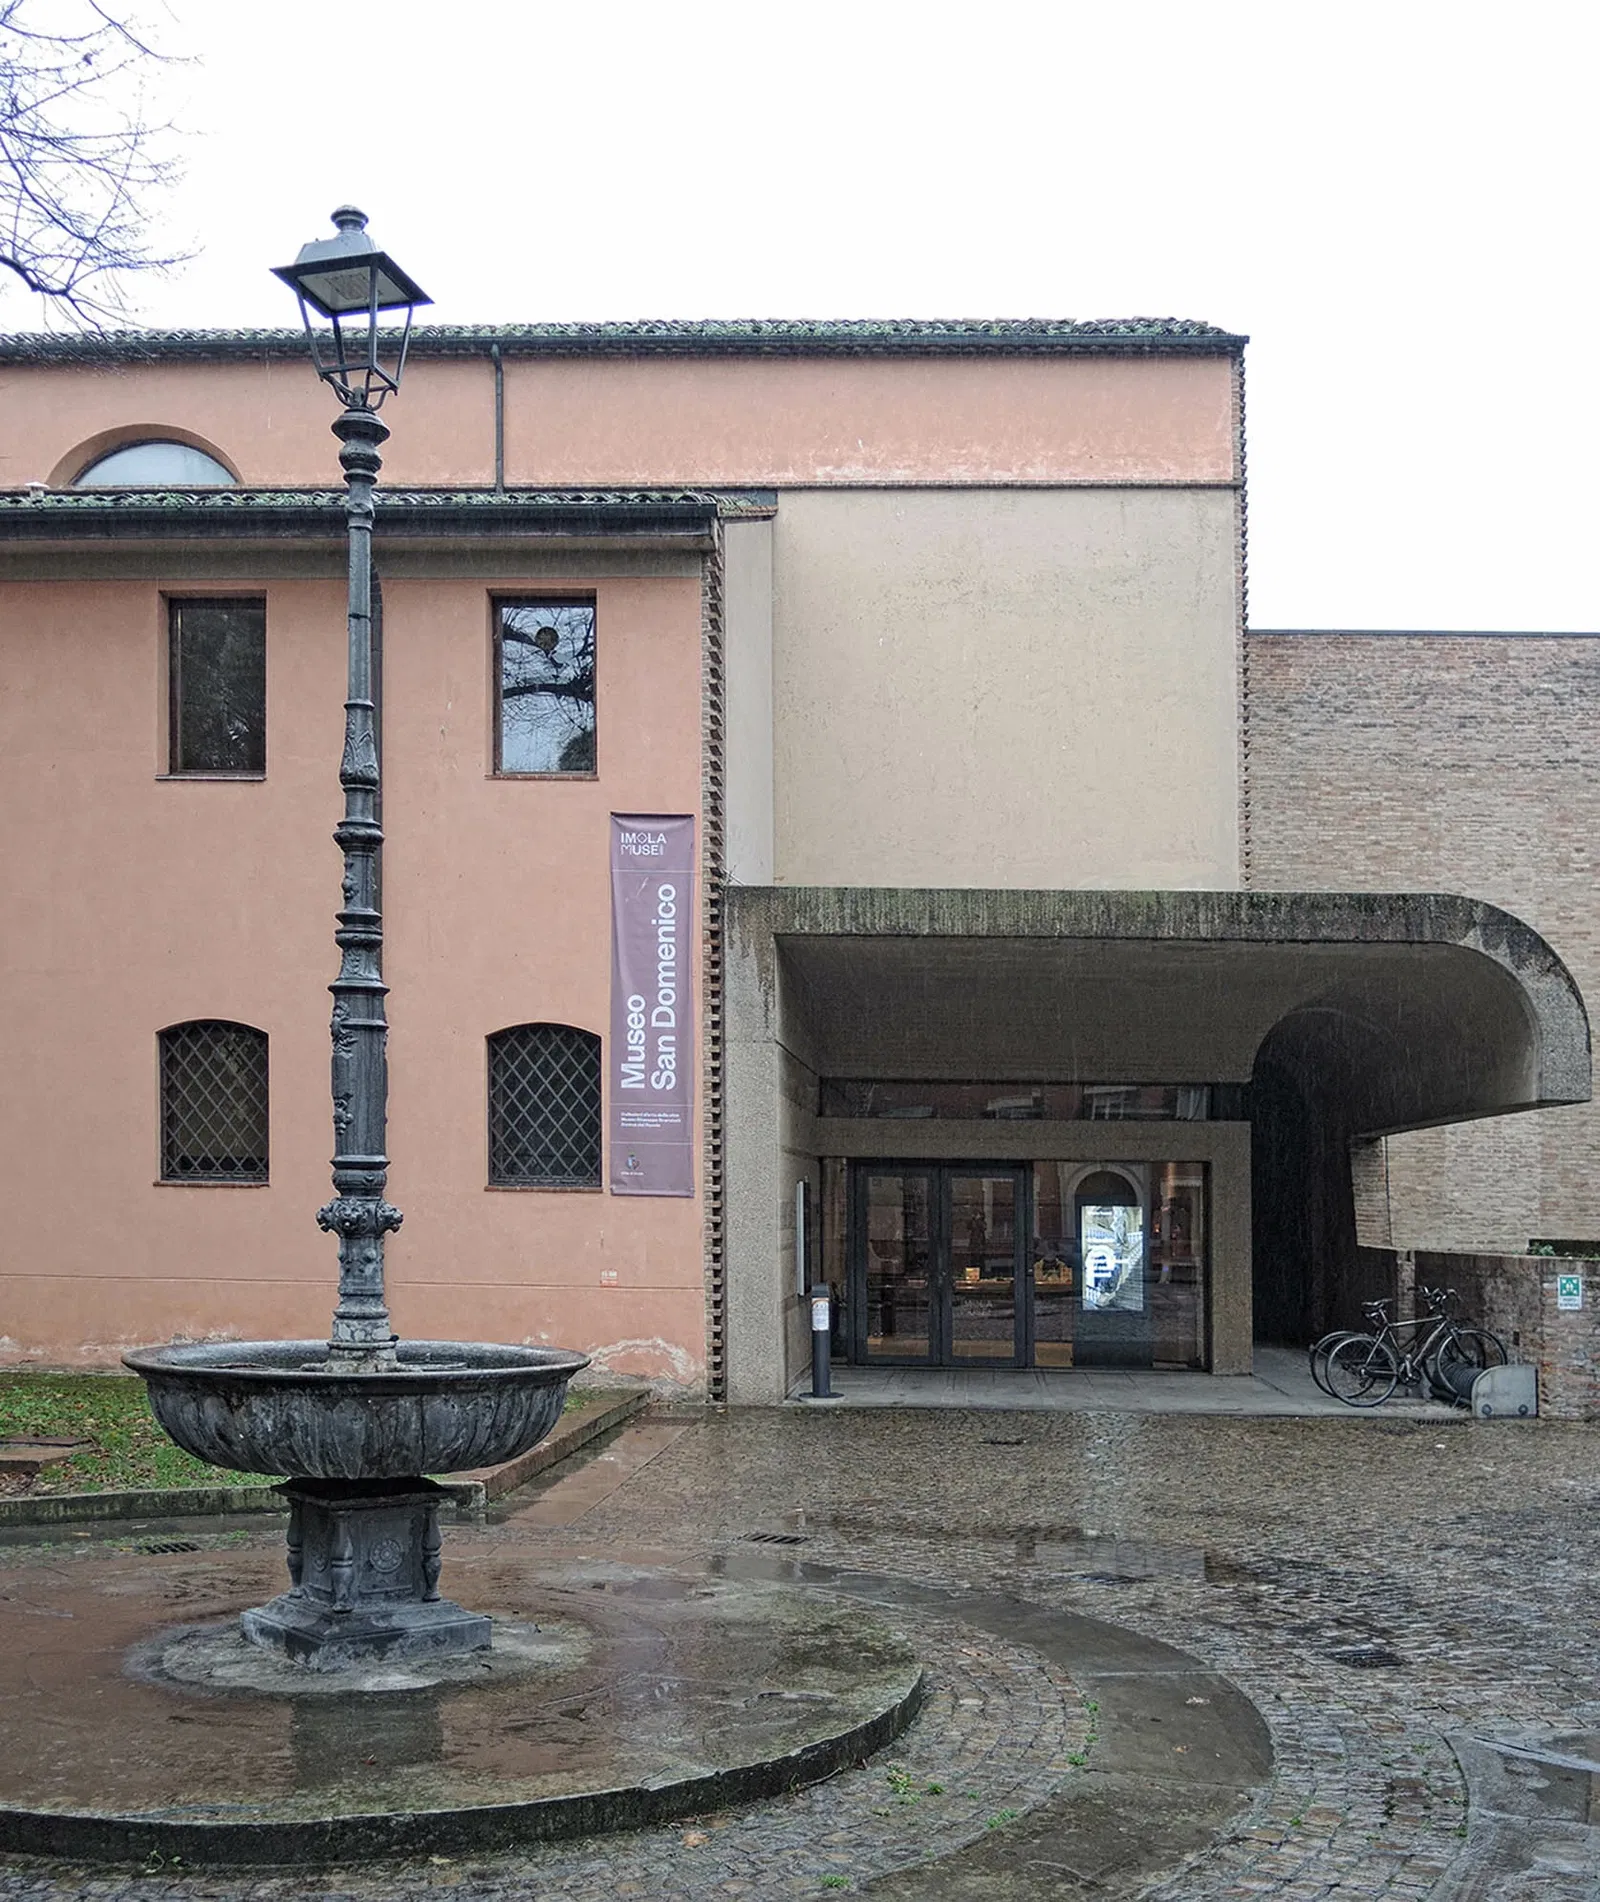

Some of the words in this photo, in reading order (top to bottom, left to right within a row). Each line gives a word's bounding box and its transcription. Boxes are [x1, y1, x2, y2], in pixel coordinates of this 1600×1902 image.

[621, 832, 667, 844] IMOLA
[621, 844, 664, 856] MUSEI
[651, 883, 676, 1028] Domenico
[620, 994, 646, 1089] Museo
[651, 1035, 676, 1091] San
